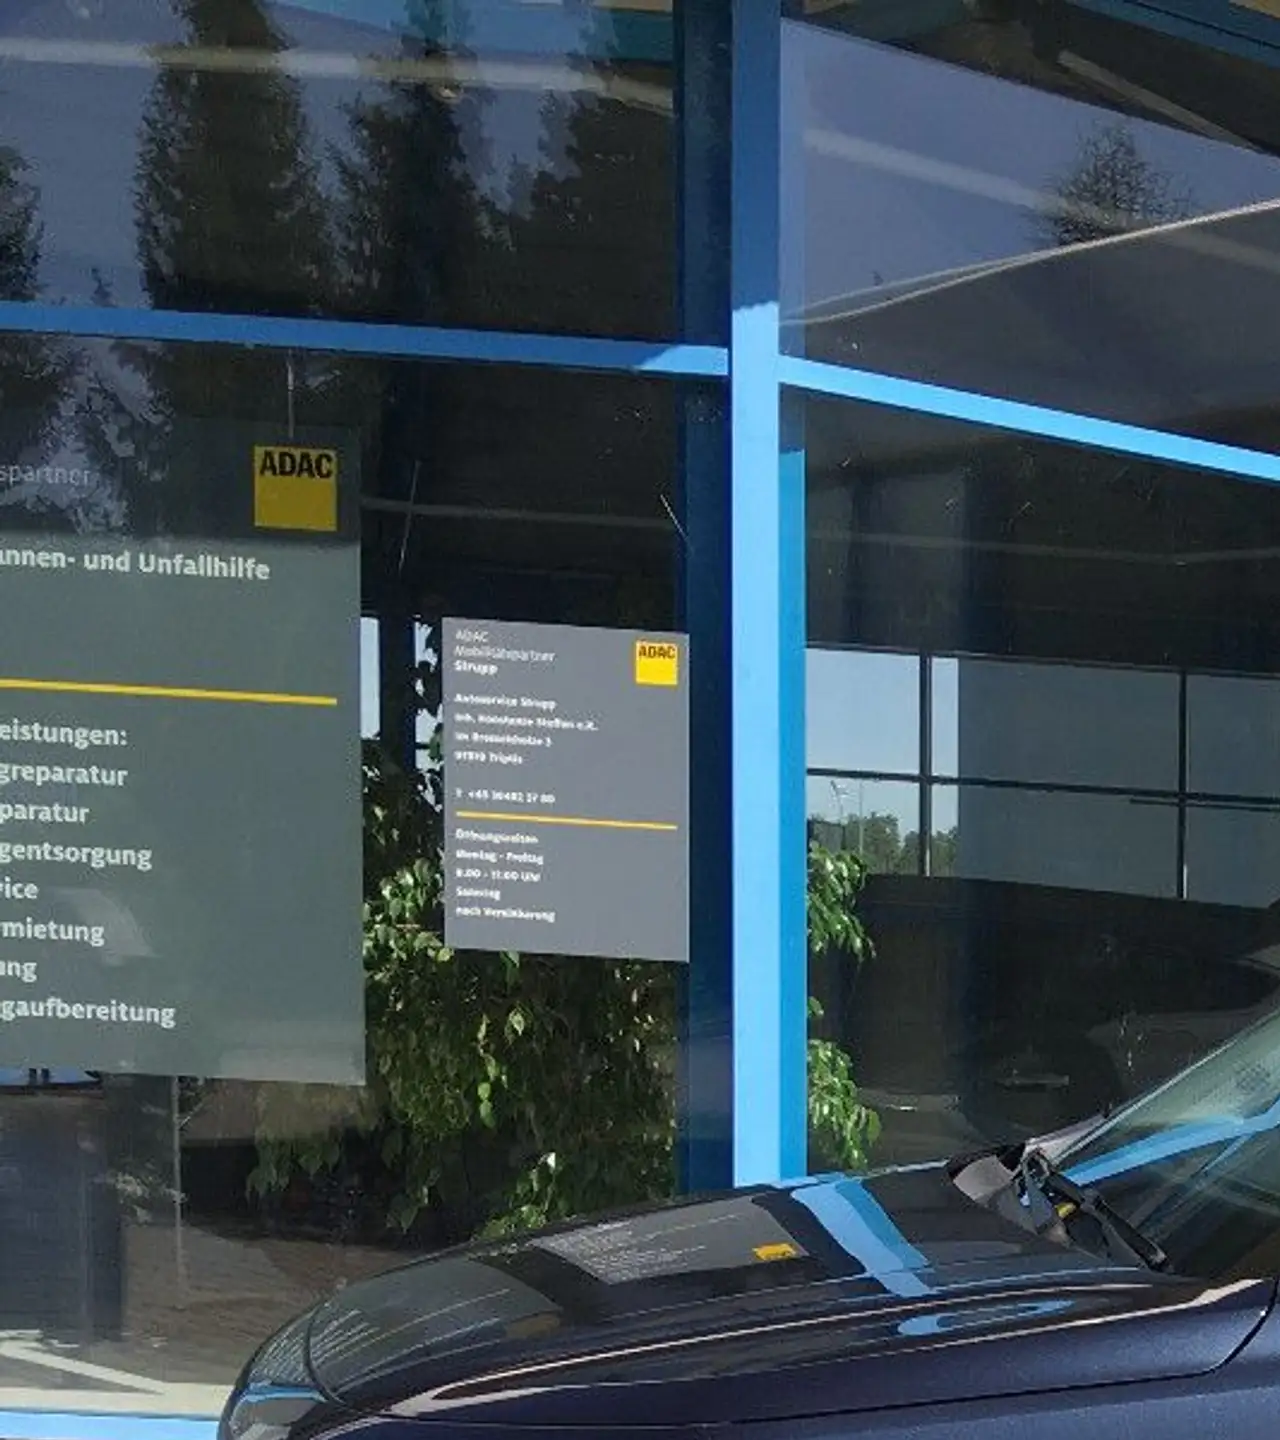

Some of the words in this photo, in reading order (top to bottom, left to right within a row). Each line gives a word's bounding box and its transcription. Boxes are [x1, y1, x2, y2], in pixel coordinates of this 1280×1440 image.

[259, 451, 333, 479] ADAC
[84, 551, 131, 573] und
[138, 553, 271, 580] Unfallhilfe
[638, 646, 676, 659] ADAC
